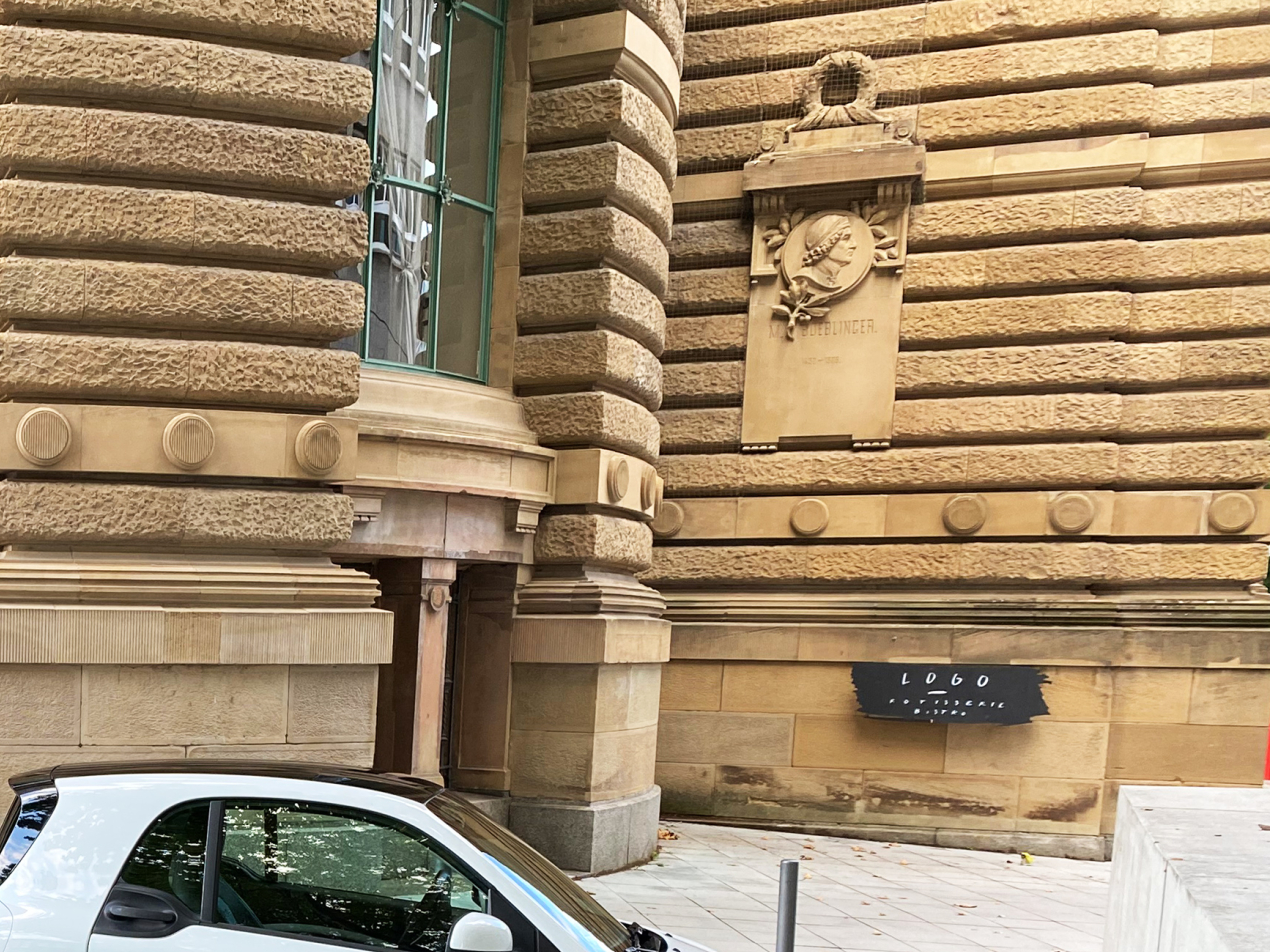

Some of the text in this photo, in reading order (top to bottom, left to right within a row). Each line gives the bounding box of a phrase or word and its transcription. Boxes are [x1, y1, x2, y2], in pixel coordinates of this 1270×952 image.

[901, 671, 989, 687] LOGO
[888, 698, 1006, 709] ROTISSERIE
[913, 708, 967, 717] BISTRO
